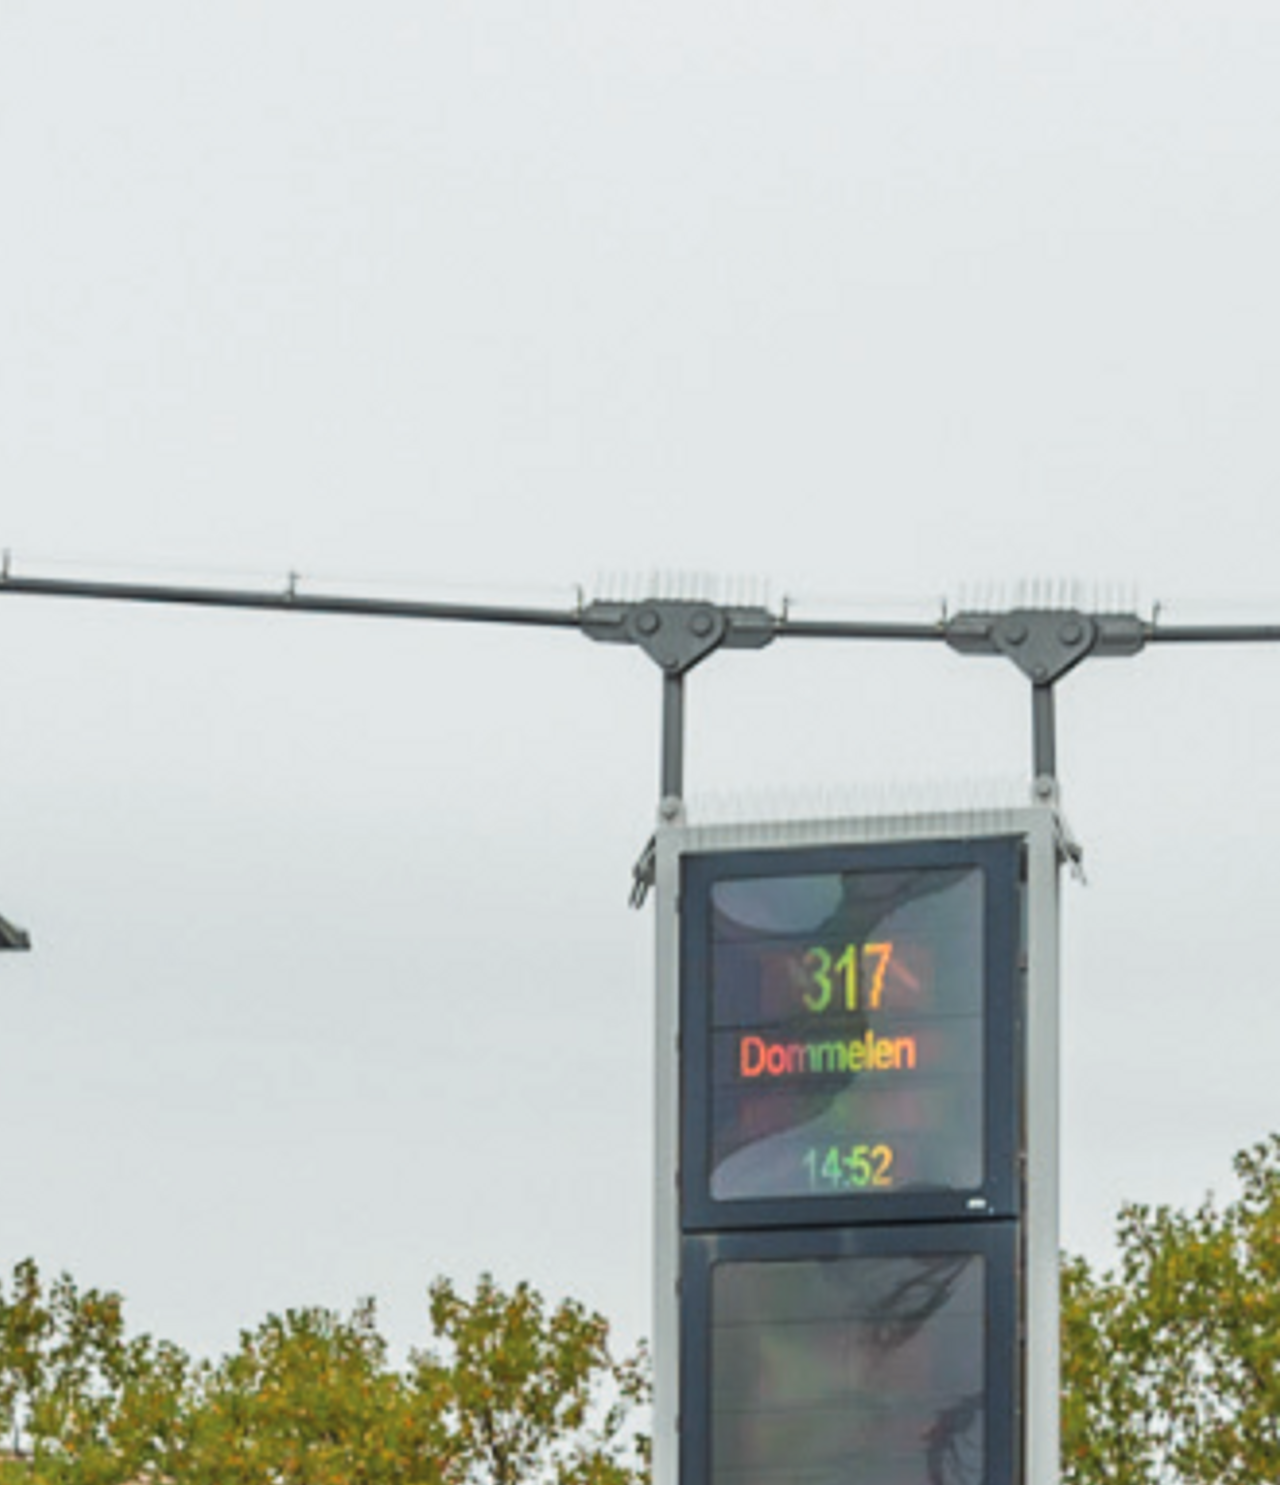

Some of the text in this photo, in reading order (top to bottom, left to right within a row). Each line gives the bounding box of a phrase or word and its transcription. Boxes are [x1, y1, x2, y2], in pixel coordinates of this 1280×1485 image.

[802, 942, 893, 1011] 317
[740, 1029, 917, 1077] Dommelen
[802, 1143, 894, 1189] 14:52
